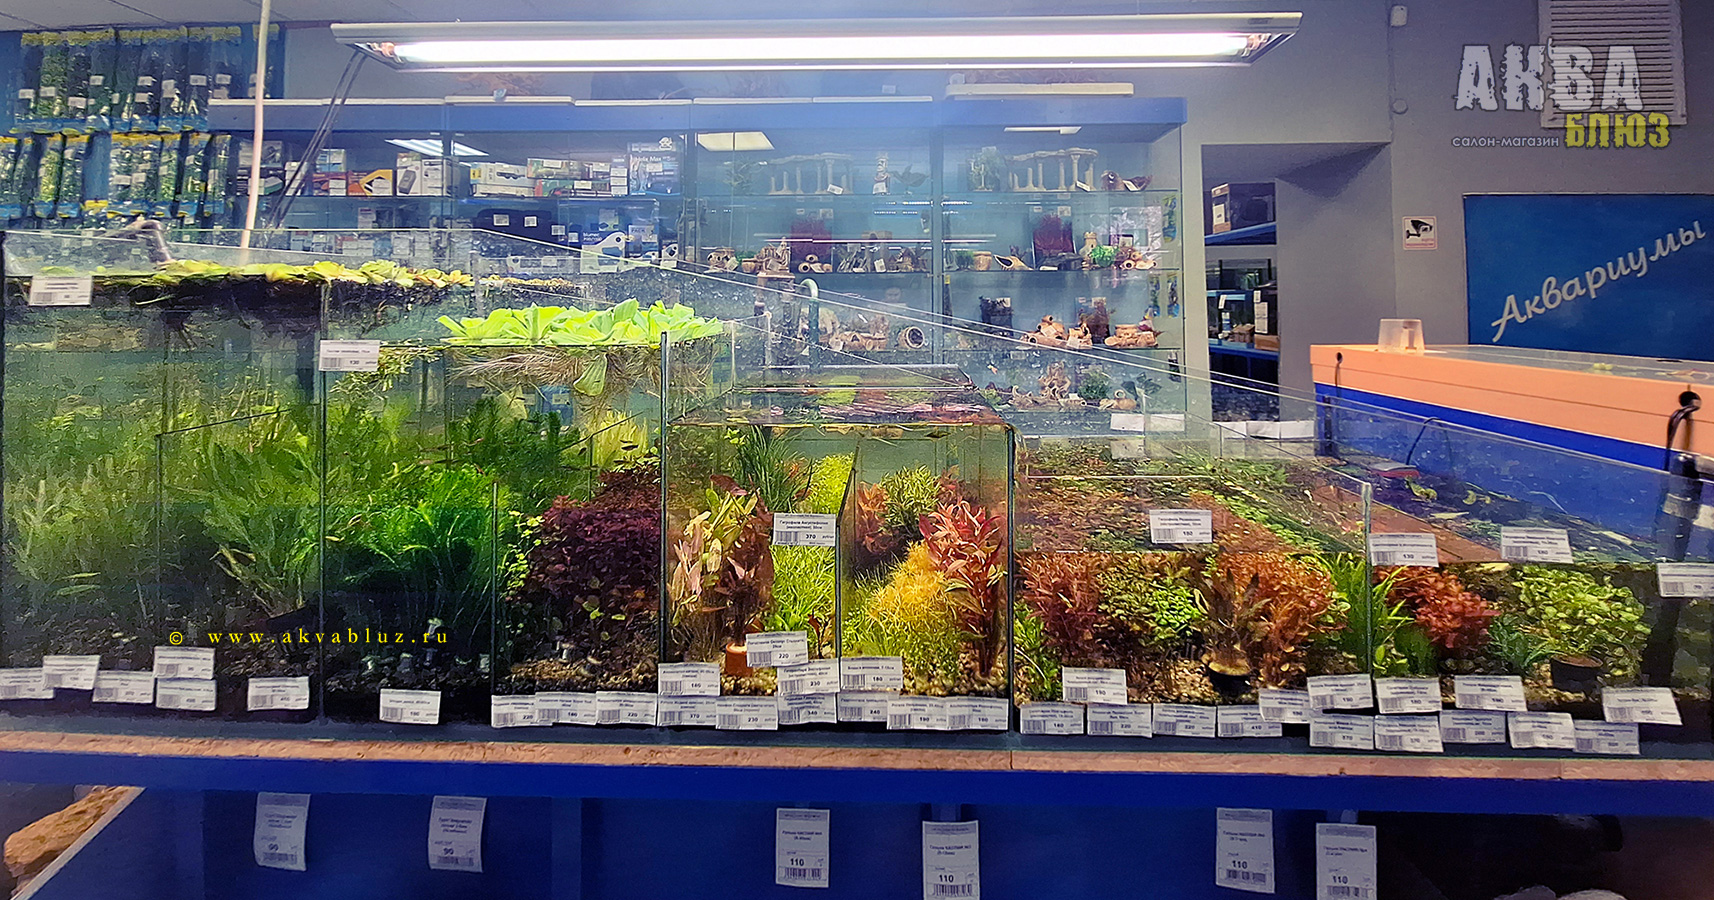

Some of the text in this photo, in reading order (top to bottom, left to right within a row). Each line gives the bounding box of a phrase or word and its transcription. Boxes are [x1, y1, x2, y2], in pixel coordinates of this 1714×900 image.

[1491, 220, 1706, 343] Аквариумы
[790, 858, 805, 866] 110
[1232, 860, 1248, 869] 110
[939, 874, 954, 882] 110
[1332, 875, 1348, 884] 110
